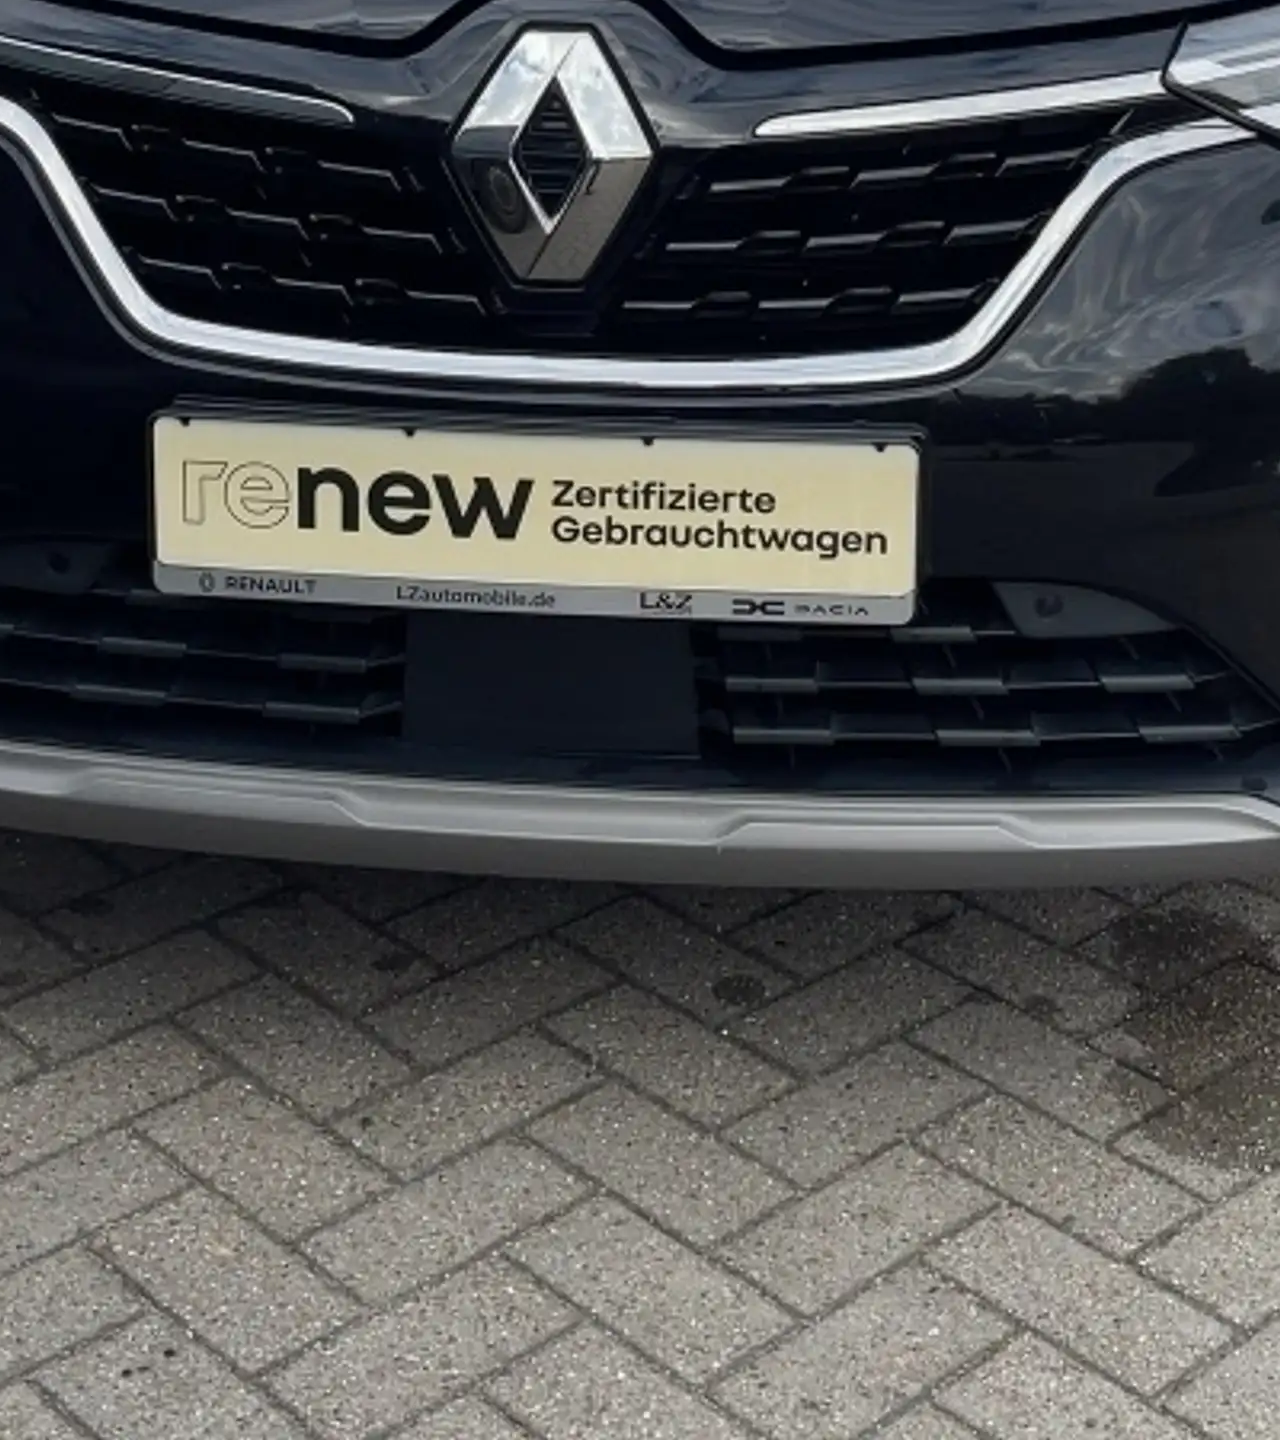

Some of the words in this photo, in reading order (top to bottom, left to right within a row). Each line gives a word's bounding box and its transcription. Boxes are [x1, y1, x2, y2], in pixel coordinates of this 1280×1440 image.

[183, 460, 535, 540] renew
[551, 479, 776, 514] Zertifizierte
[551, 515, 888, 560] Gebrauchtwagen
[225, 575, 317, 595] RENAULT
[396, 585, 555, 609] LZautomobile.de
[640, 591, 692, 609] L&Z
[794, 604, 869, 616] DACIA
